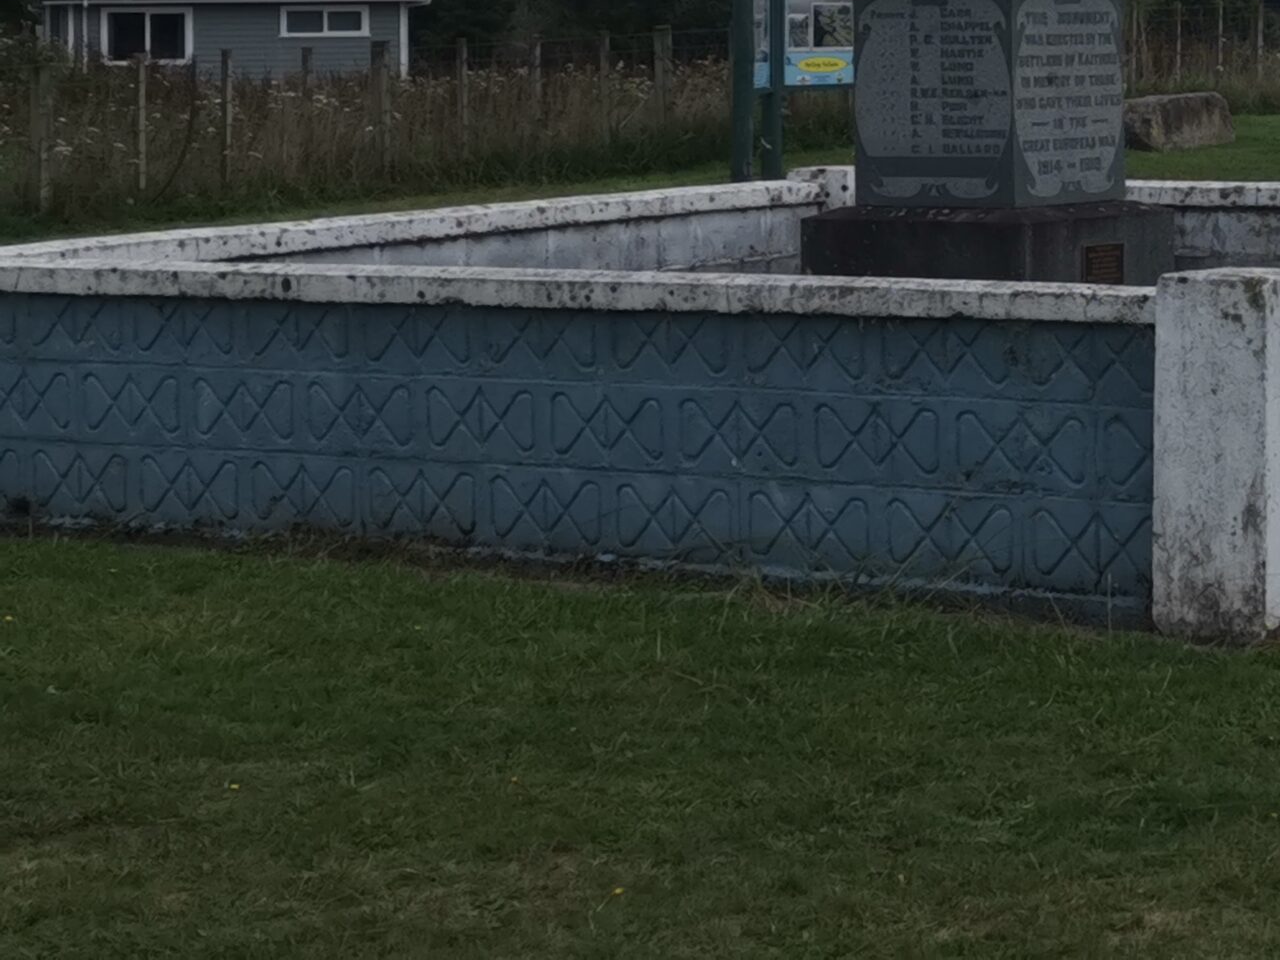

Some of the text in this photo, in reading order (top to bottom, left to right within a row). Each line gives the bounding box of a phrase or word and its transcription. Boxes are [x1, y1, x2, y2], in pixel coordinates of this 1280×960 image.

[1046, 33, 1084, 46] ERECTED
[1098, 33, 1112, 45] THE
[1019, 54, 1062, 68] SETTLERS
[1065, 53, 1076, 67] OF
[1033, 75, 1071, 88] MEMORY
[1074, 74, 1085, 87] OF
[1088, 74, 1115, 86] THOSE
[1016, 94, 1121, 110] WHO GAVE THEIR LIVES
[1053, 116, 1087, 130] IN THE
[1022, 135, 1116, 152] GREAT EUROPEAN WAR
